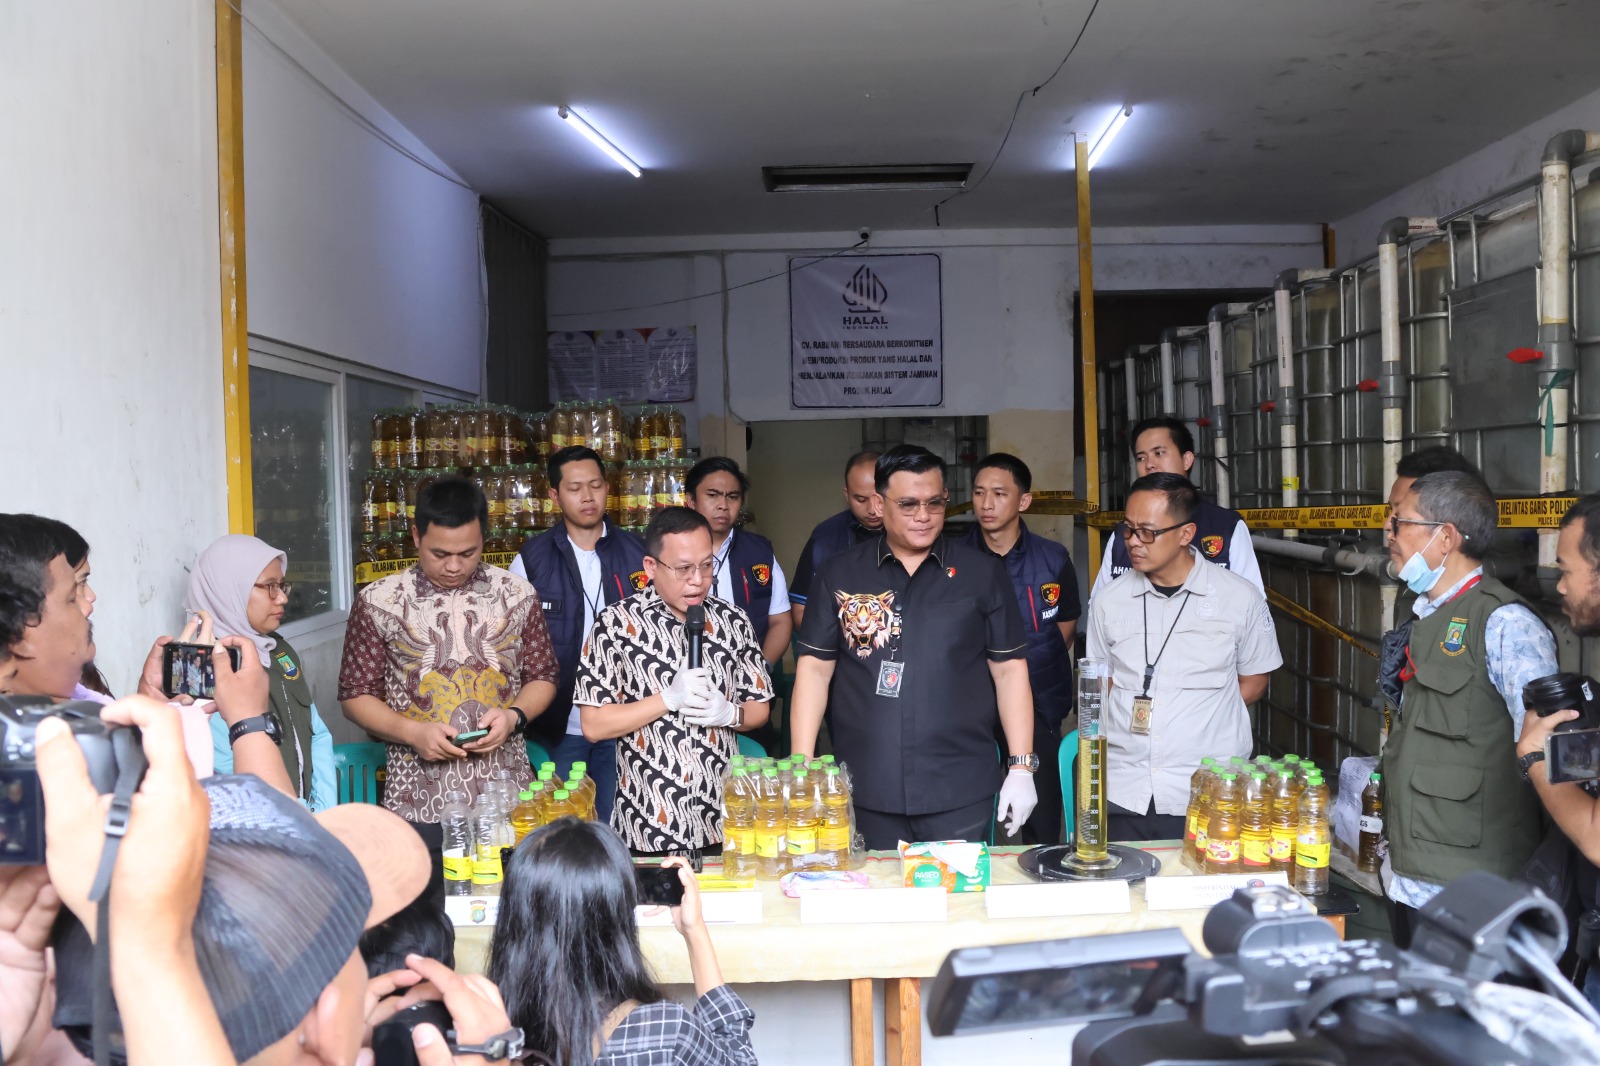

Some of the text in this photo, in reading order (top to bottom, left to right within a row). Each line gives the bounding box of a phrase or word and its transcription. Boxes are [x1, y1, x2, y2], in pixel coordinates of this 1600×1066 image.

[843, 316, 888, 325] HALAL
[801, 341, 812, 349] CV.
[887, 339, 934, 348] BERKOMITMEN
[850, 356, 876, 364] PRODUK
[878, 355, 896, 364] YANG
[897, 355, 918, 363] HALAL
[919, 354, 933, 363] DAN
[884, 371, 908, 379] SISTEM
[909, 370, 938, 379] JAMINAN
[843, 386, 892, 395] PROK HALAL
[1501, 501, 1528, 515] MELINTAS
[1529, 501, 1547, 514] GARIS
[1538, 517, 1552, 525] POLICE
[372, 561, 396, 572] DILARANG
[915, 871, 939, 879] PASEO
